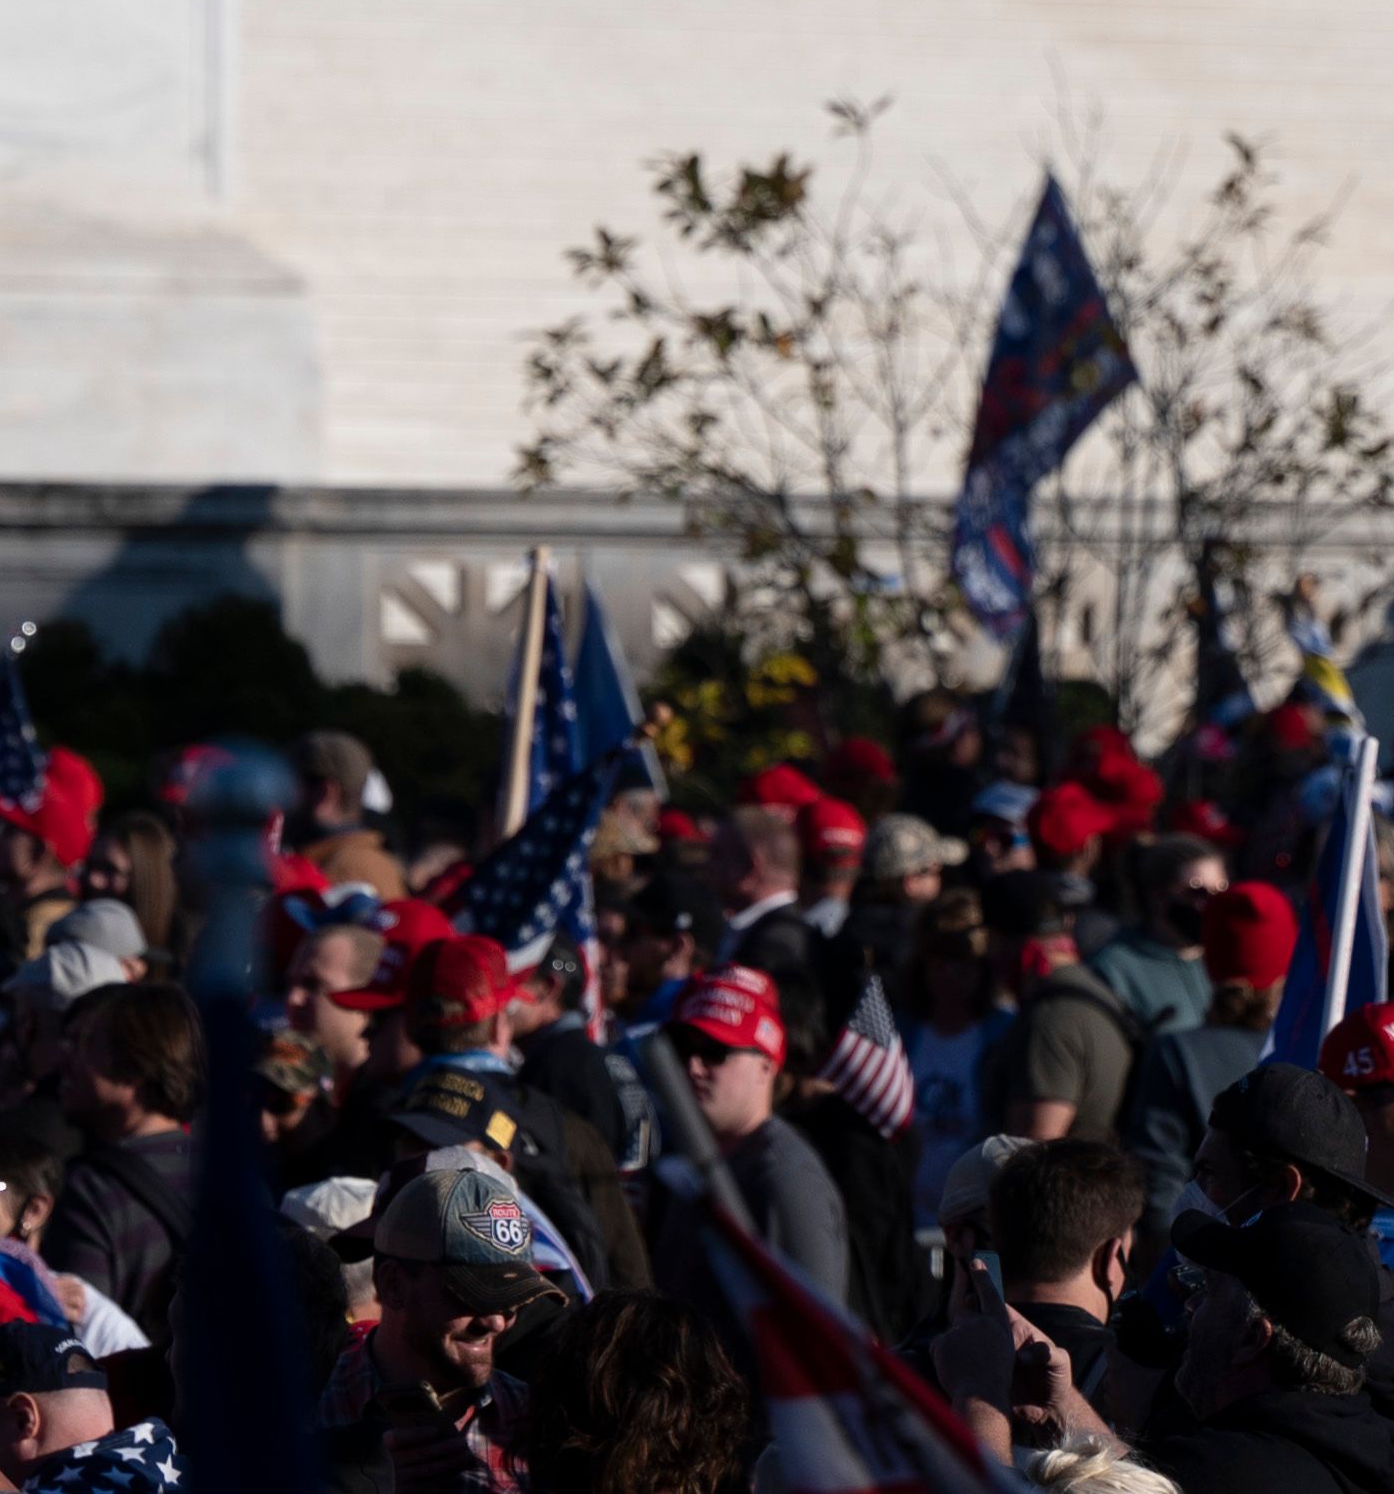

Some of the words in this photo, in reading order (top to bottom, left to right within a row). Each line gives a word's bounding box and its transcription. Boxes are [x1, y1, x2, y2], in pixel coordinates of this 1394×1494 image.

[1343, 1047, 1375, 1077] 45
[492, 1206, 519, 1218] ROUTE
[495, 1218, 524, 1244] 66
